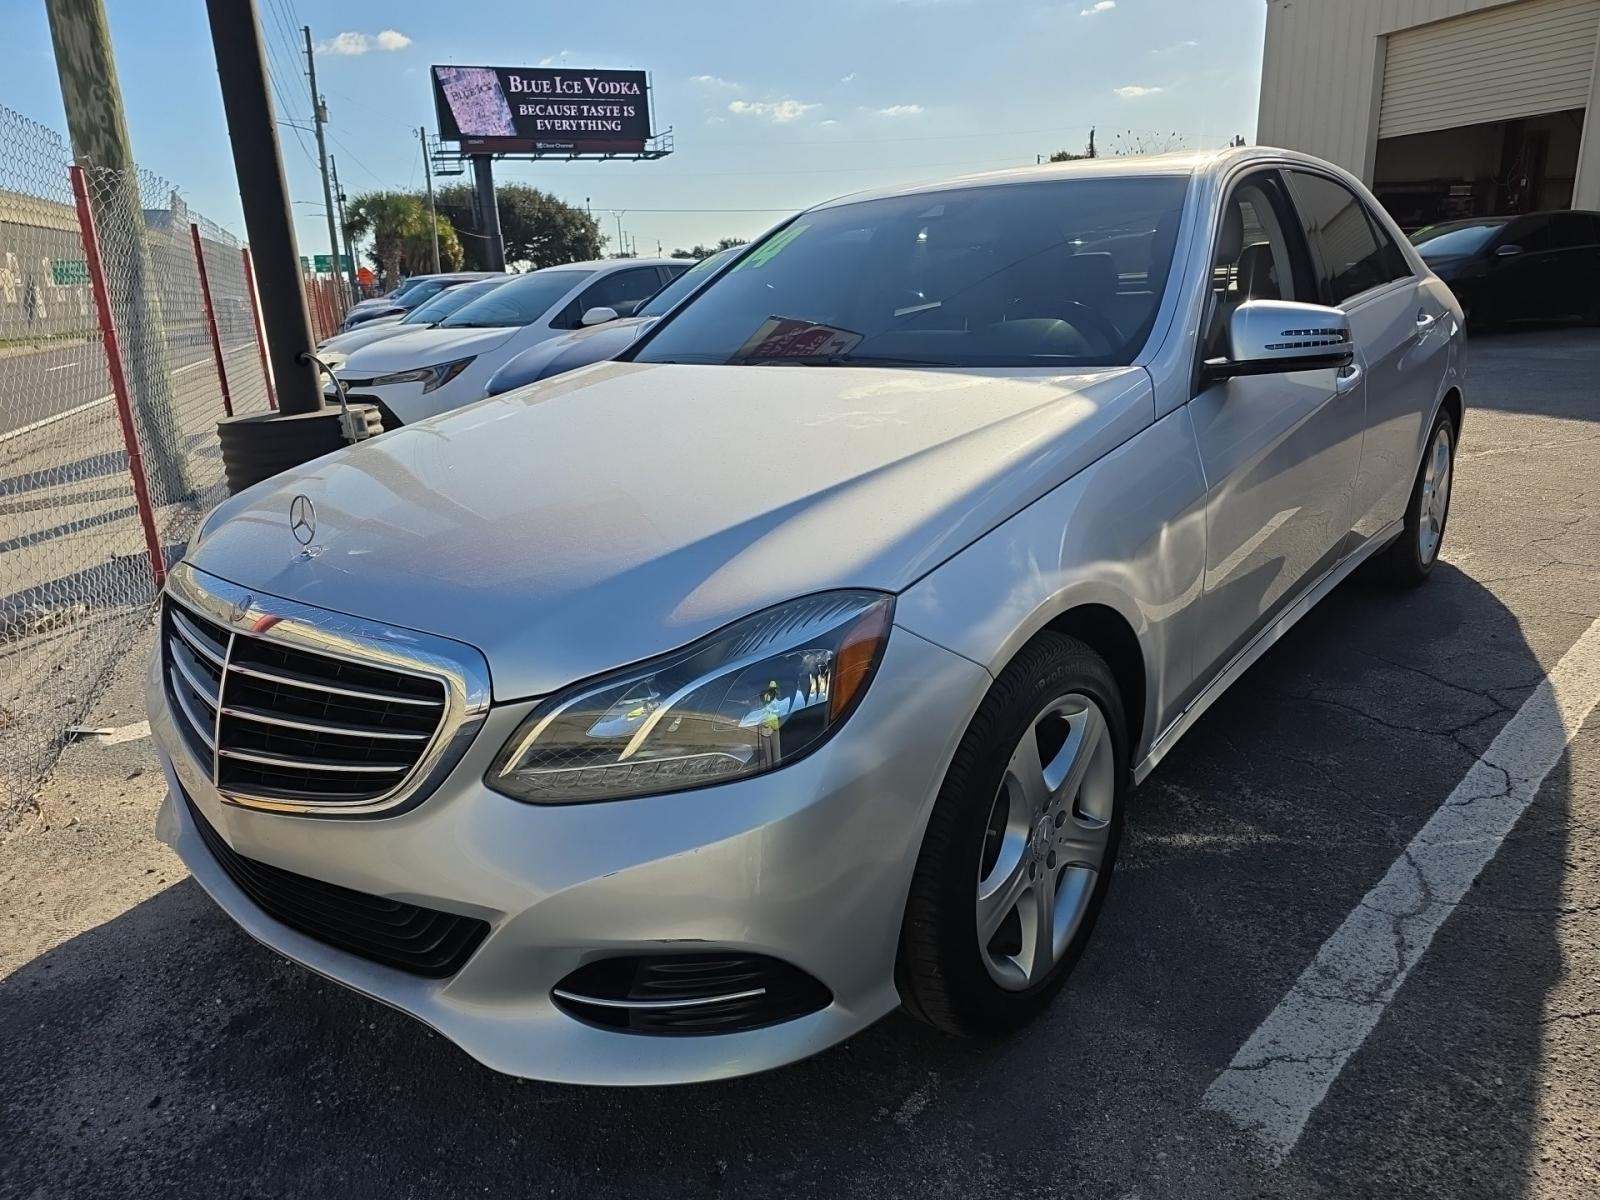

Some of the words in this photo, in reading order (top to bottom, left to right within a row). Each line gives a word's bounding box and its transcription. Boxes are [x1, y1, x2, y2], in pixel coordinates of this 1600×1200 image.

[508, 75, 552, 93] BLUE
[554, 76, 583, 94] ICE
[584, 77, 641, 95] VODKA
[519, 104, 579, 116] BECAUSE
[580, 105, 621, 117] TASTE
[623, 106, 636, 117] IS
[536, 119, 622, 131] EVERYTHING
